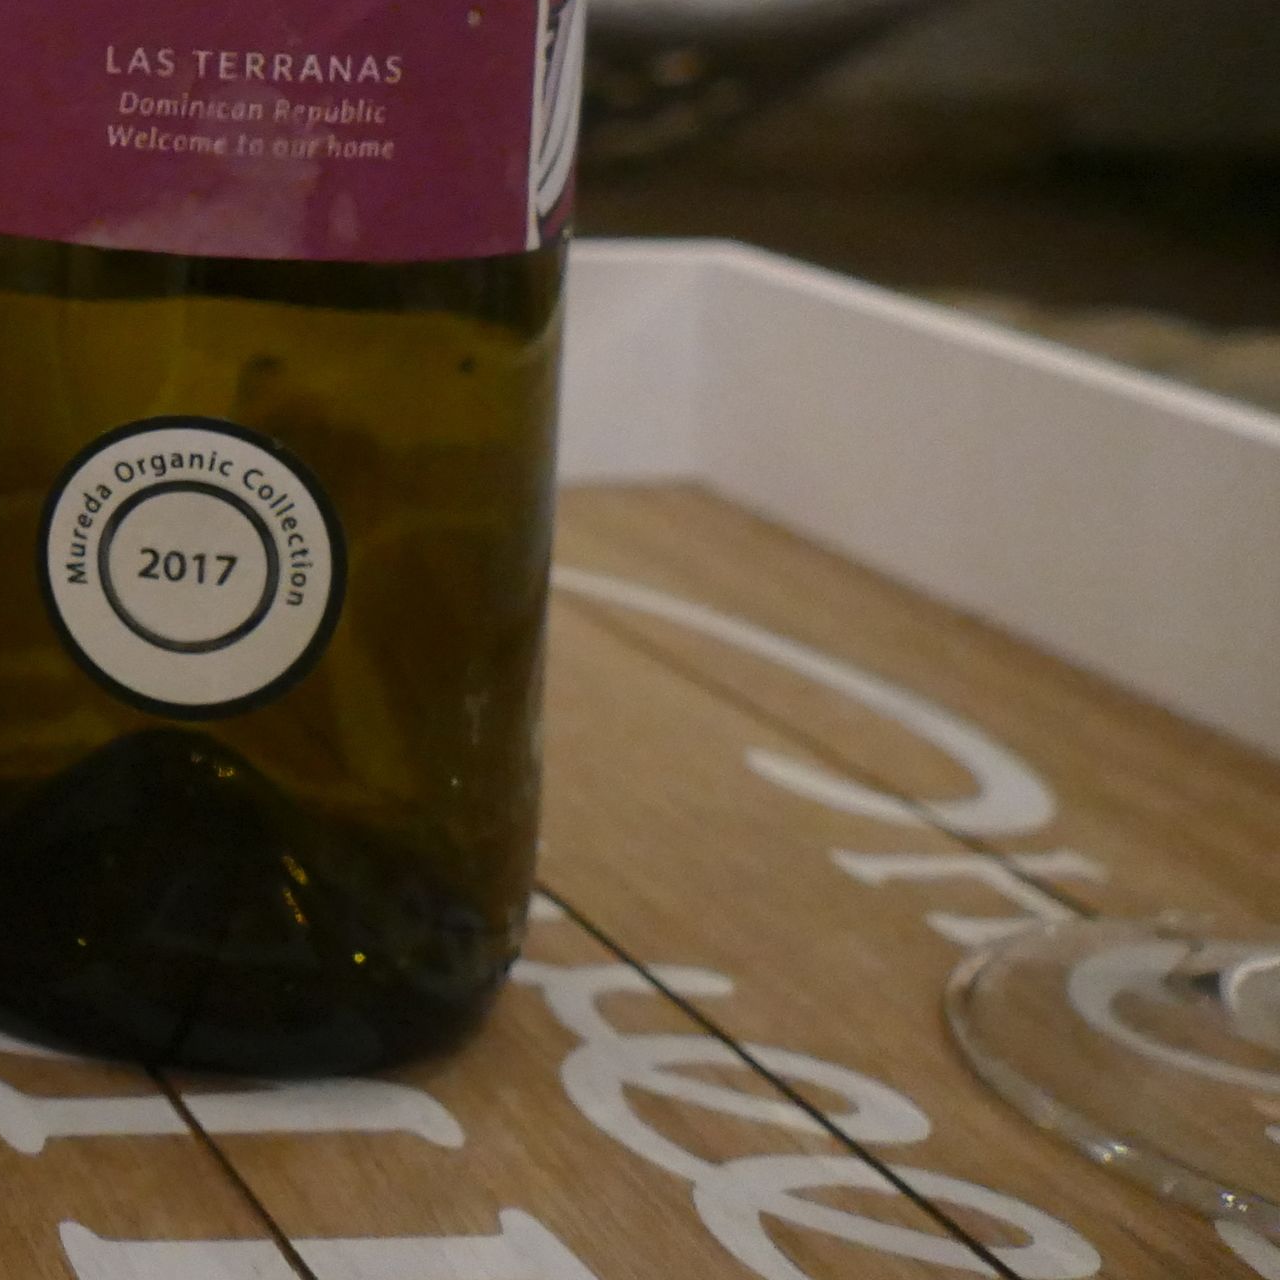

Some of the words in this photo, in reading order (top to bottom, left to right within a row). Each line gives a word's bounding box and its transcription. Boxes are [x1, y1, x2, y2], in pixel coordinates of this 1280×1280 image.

[105, 45, 176, 77] LAS
[191, 49, 402, 84] TERRANAS
[117, 90, 265, 121] Dominican
[274, 98, 389, 131] Republic
[106, 124, 228, 156] Welcome
[237, 134, 265, 156] to
[272, 137, 323, 160] our
[327, 133, 395, 161] home
[66, 483, 113, 585] Mureda
[114, 451, 234, 484] Organic
[243, 468, 314, 607] Collection
[138, 546, 239, 587] 2017
